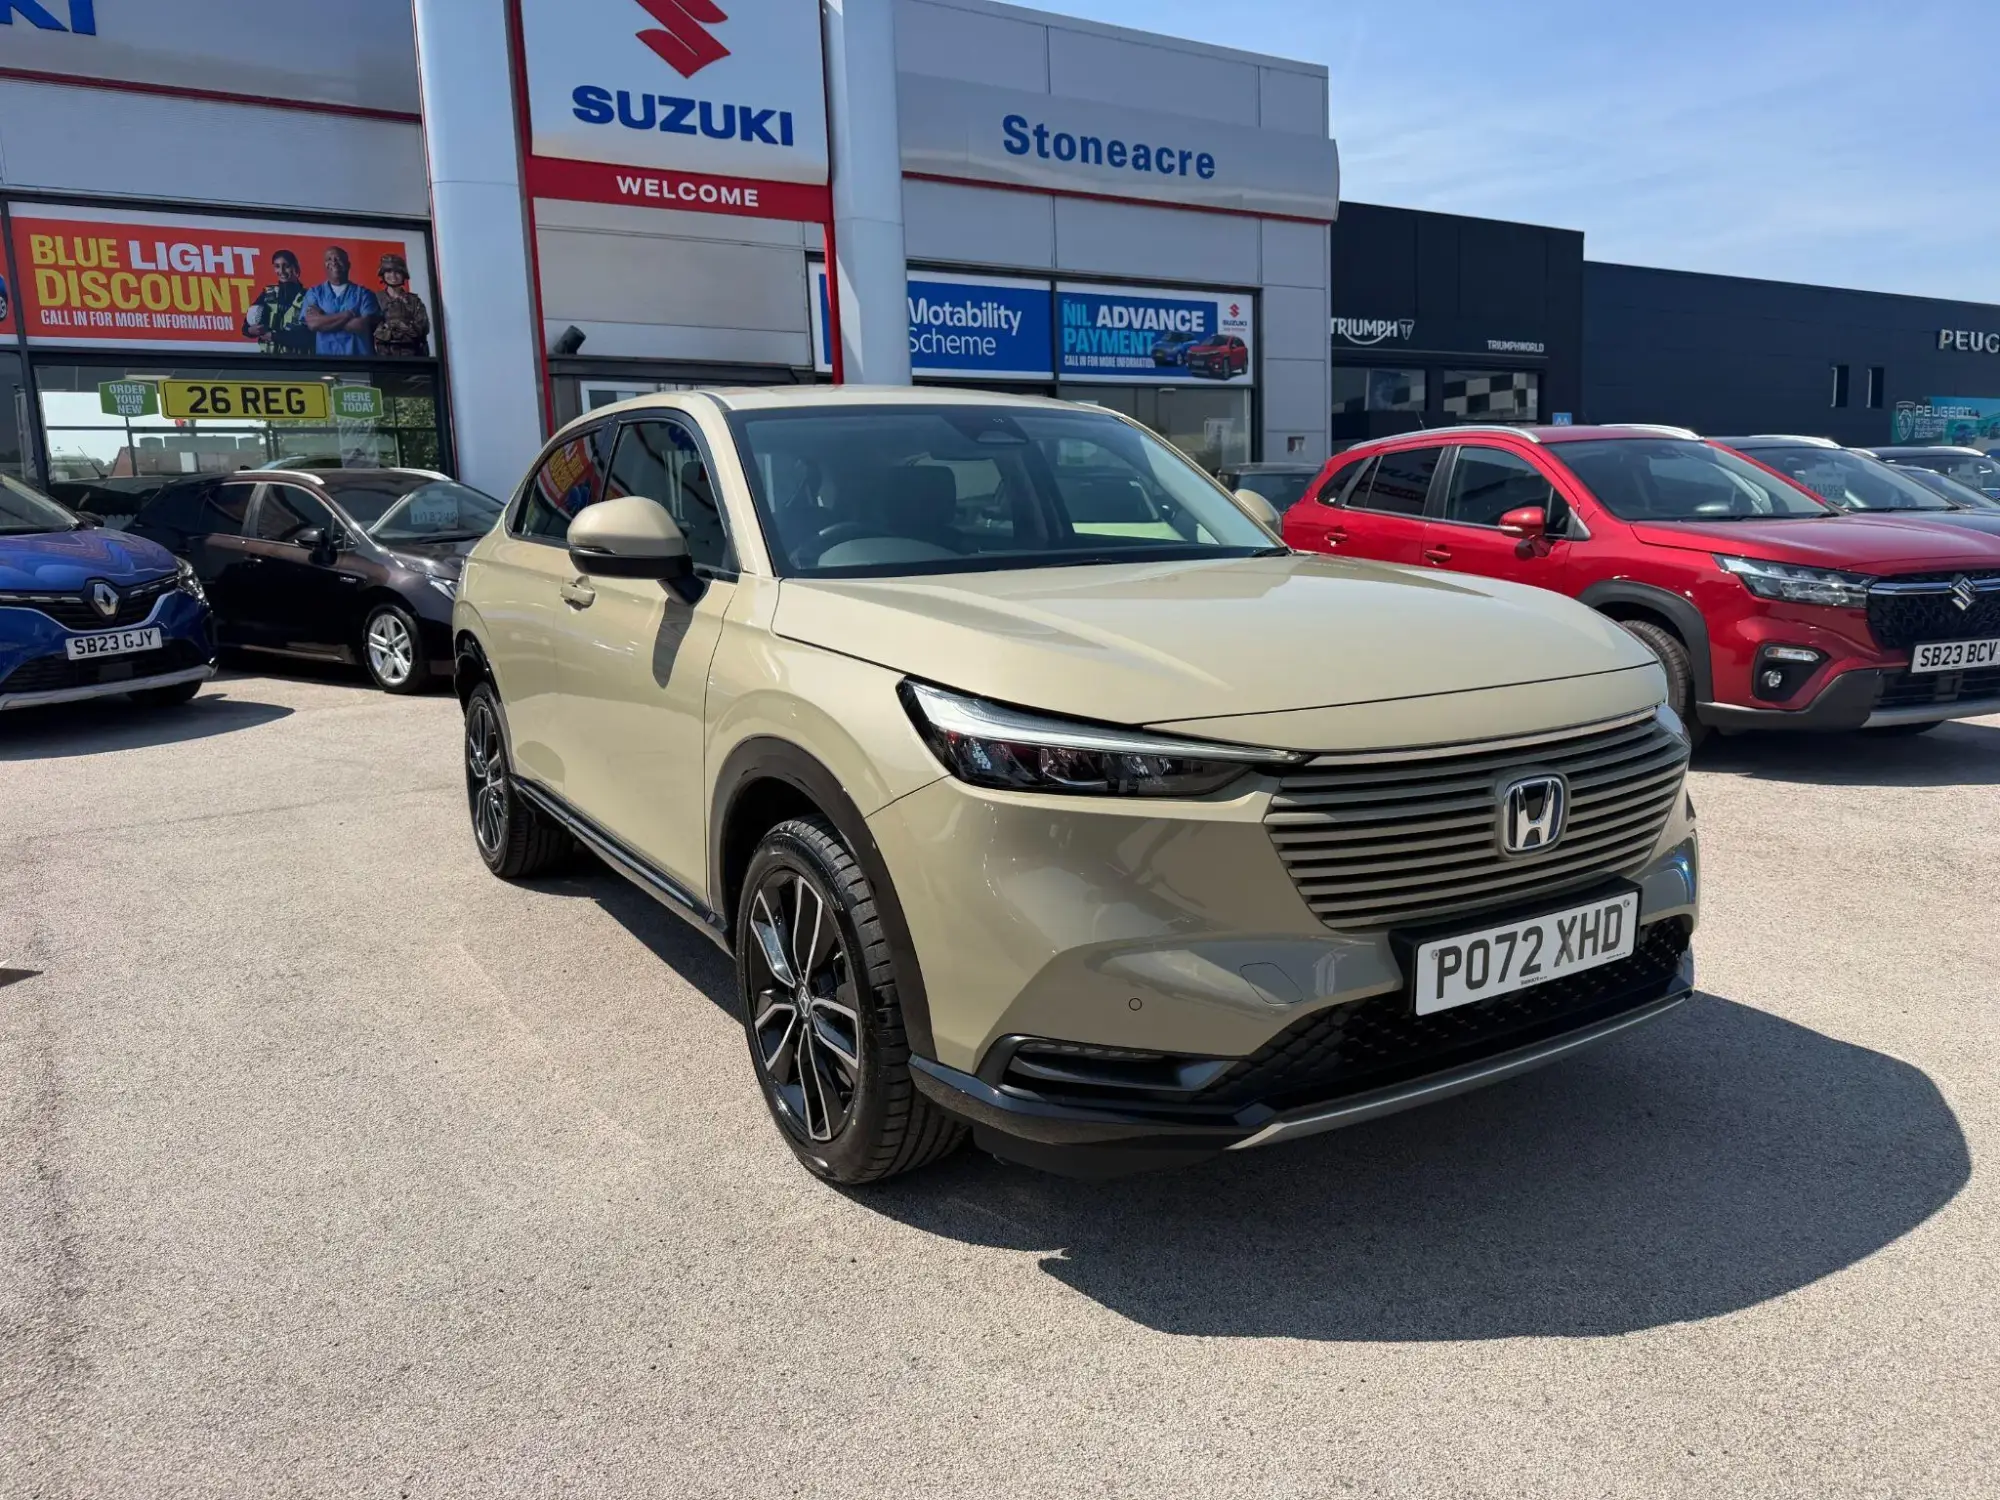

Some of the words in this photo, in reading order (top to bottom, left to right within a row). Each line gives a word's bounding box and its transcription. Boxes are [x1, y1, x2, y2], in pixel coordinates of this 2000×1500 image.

[572, 84, 794, 147] SUZUKI
[1002, 114, 1215, 180] Stoneacre
[616, 175, 759, 207] WELCOME
[30, 234, 121, 268] BLUE
[128, 240, 260, 275] LIGHT
[34, 268, 256, 314] DISCOUNT
[41, 309, 71, 326] CALL
[73, 310, 88, 326] IN
[90, 311, 114, 327] FOR
[115, 312, 151, 328] MORE
[152, 314, 234, 331] INFORMATION
[908, 297, 1022, 336] Motability
[1063, 302, 1091, 326] NIL
[1096, 304, 1205, 332] ADVANCE
[909, 326, 996, 356] Scheme
[1064, 327, 1156, 355] PAYMENT
[1330, 317, 1398, 344] TRIUMPH
[1938, 328, 2000, 354] PEUG
[1064, 355, 1079, 367] CALL
[1087, 356, 1099, 367] FOR
[1099, 356, 1116, 368] MORE
[109, 384, 146, 395] ORDER
[114, 394, 144, 405] YOUR
[186, 385, 231, 414] 26
[240, 387, 306, 415] REG
[343, 391, 371, 402] HERE
[116, 404, 142, 414] NEW
[340, 401, 375, 413] TODAY
[1915, 404, 1972, 418] PEUGEOT
[74, 634, 120, 655] SB23
[123, 630, 153, 649] GJY
[1920, 644, 1963, 667] SB23
[1965, 641, 1998, 663] BCV
[1436, 925, 1544, 1000] PO72
[1553, 903, 1623, 968] XHD
